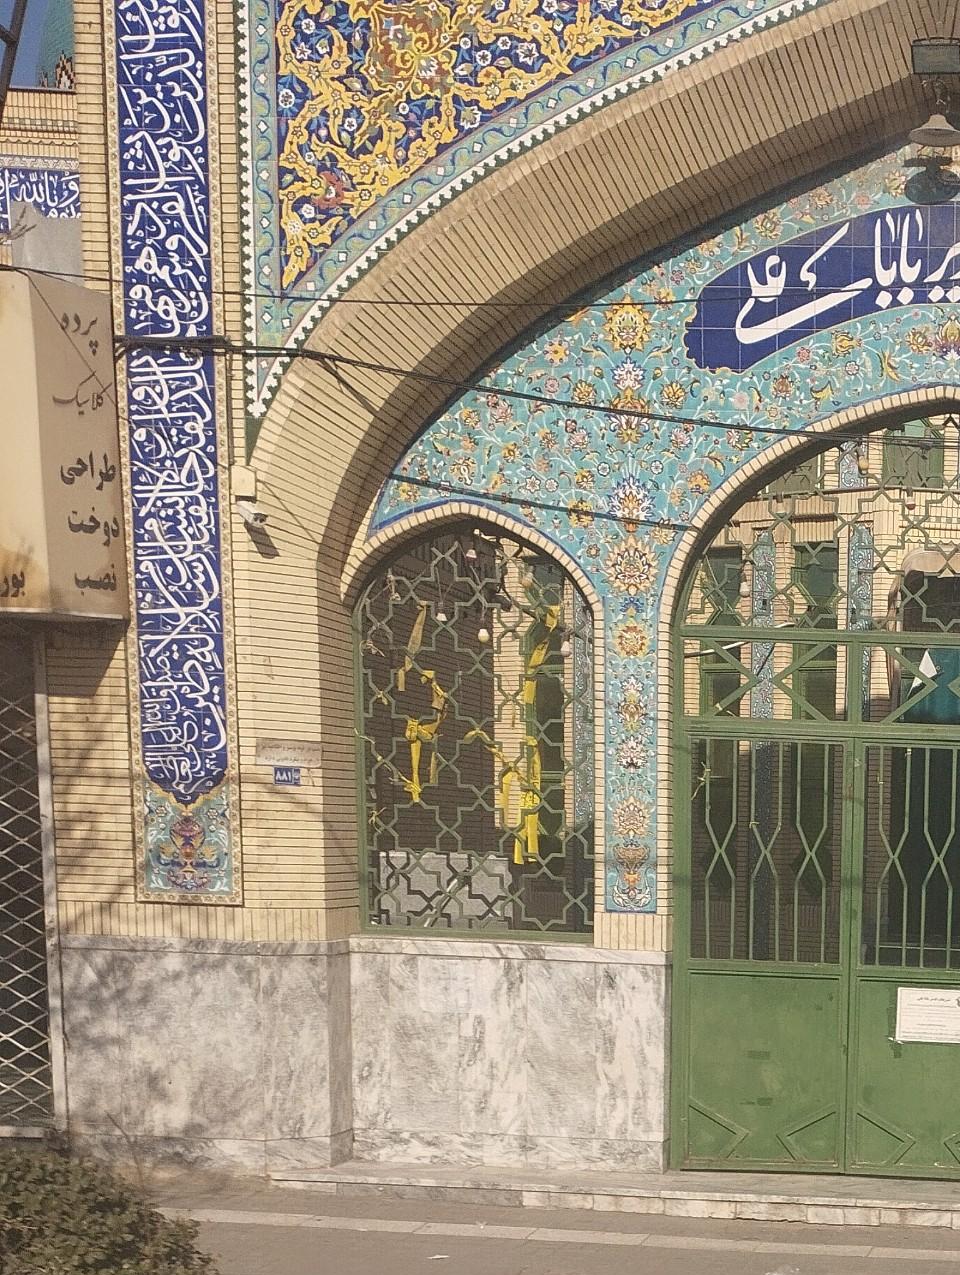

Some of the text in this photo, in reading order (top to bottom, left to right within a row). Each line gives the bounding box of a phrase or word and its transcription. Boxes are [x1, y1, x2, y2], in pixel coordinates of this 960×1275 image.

[61, 312, 98, 356] پرده
[60, 450, 117, 491] طراحی
[67, 507, 120, 546] دوخت
[74, 563, 117, 596] نصب
